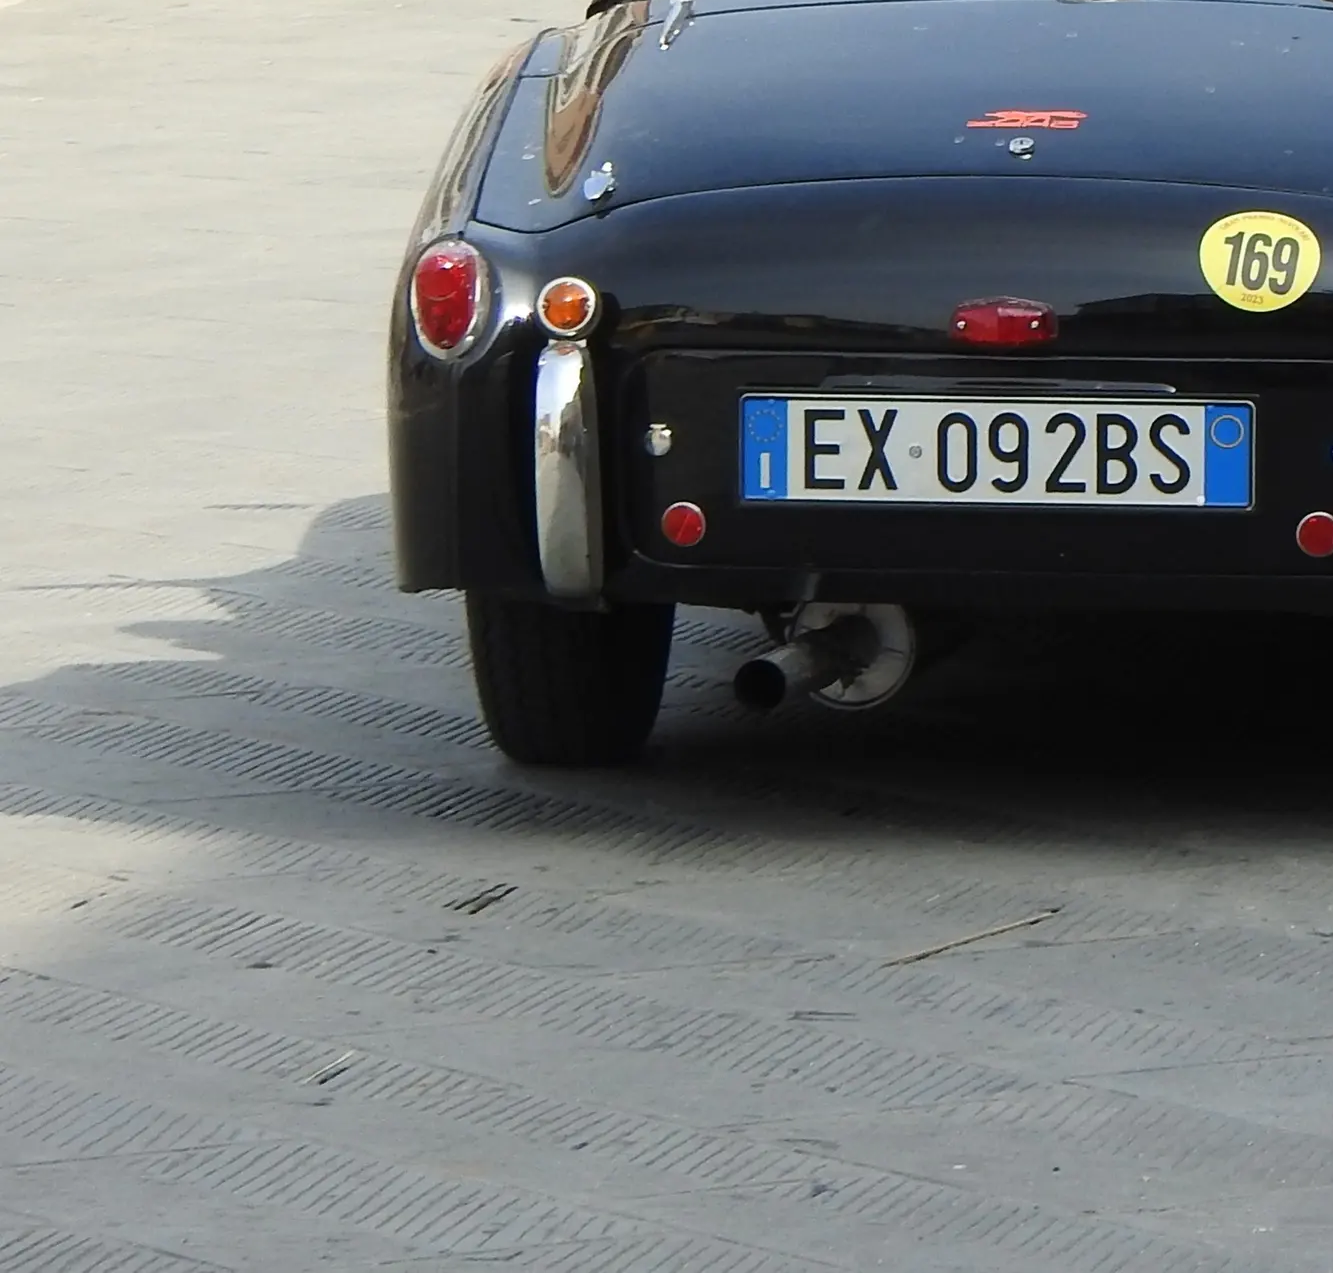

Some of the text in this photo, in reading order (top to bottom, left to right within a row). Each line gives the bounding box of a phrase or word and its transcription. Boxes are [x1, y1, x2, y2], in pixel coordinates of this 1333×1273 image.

[1224, 231, 1300, 295] 169
[804, 408, 899, 490] EX
[936, 411, 1192, 495] 092BS
